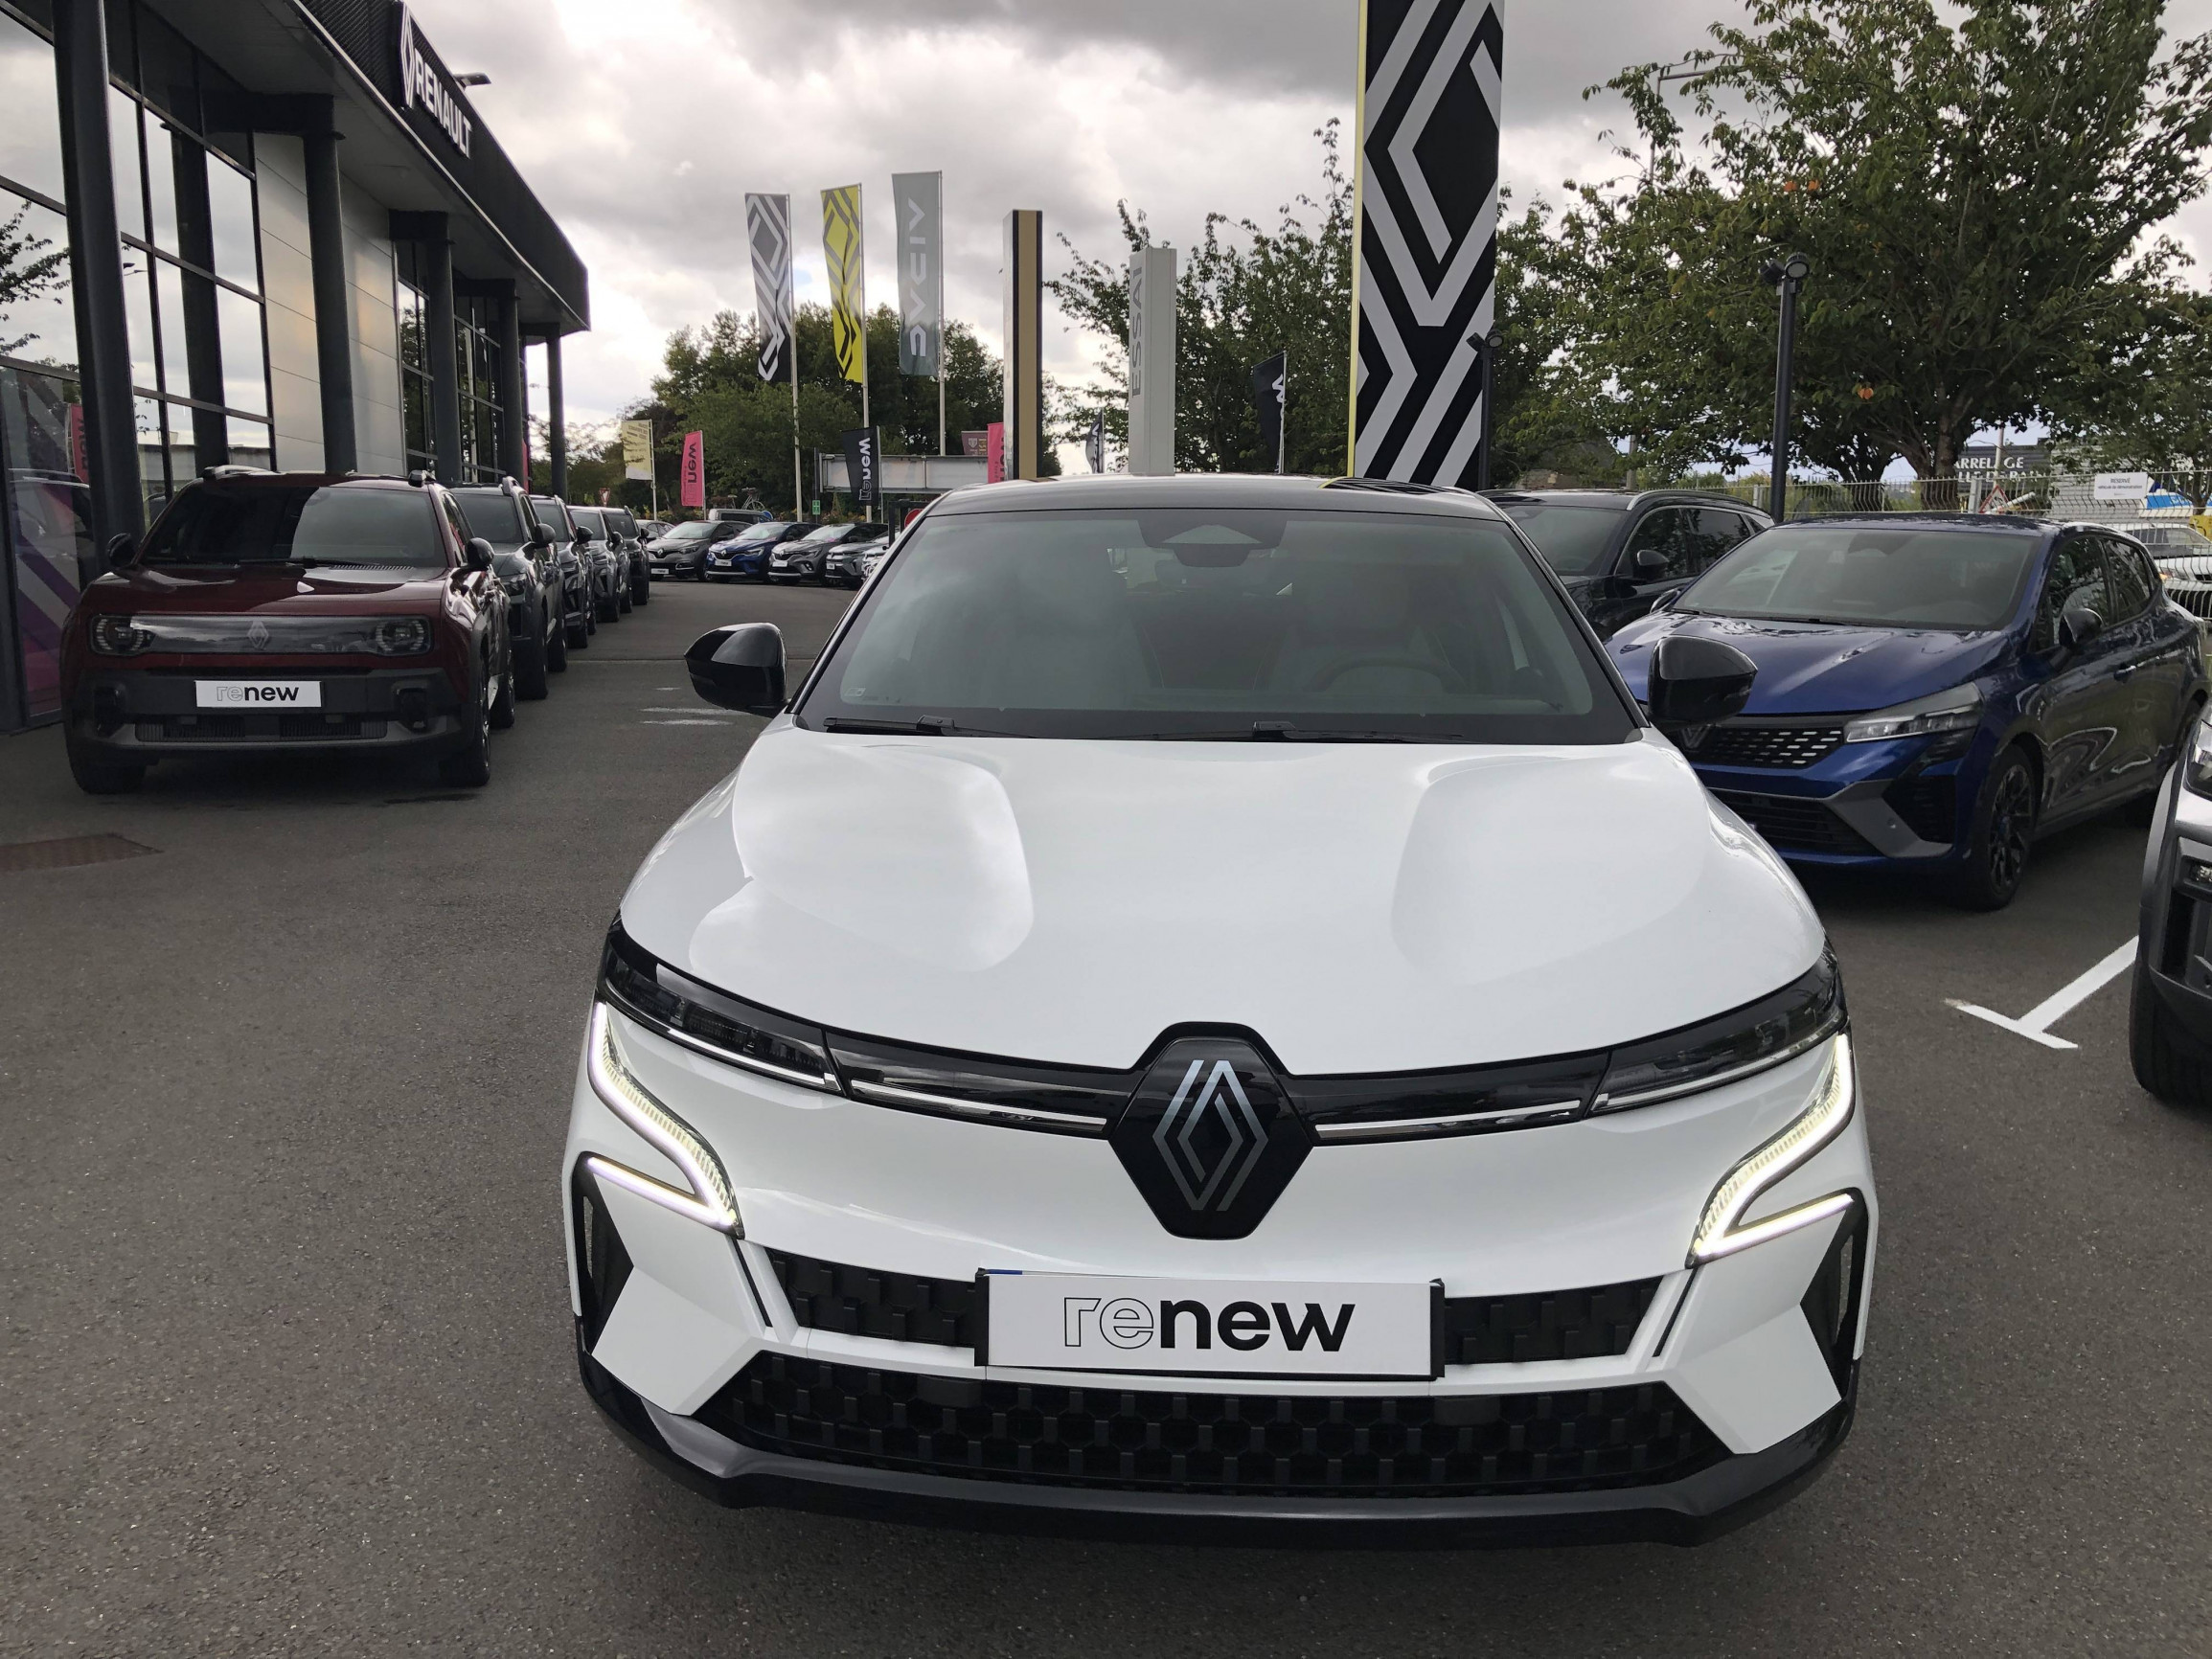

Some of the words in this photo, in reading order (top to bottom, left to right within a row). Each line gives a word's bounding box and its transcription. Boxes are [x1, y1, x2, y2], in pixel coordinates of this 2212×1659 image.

[415, 48, 472, 159] RENAULT
[1132, 266, 1143, 398] ESSAI
[216, 686, 299, 701] renew
[1064, 1296, 1356, 1352] renew
